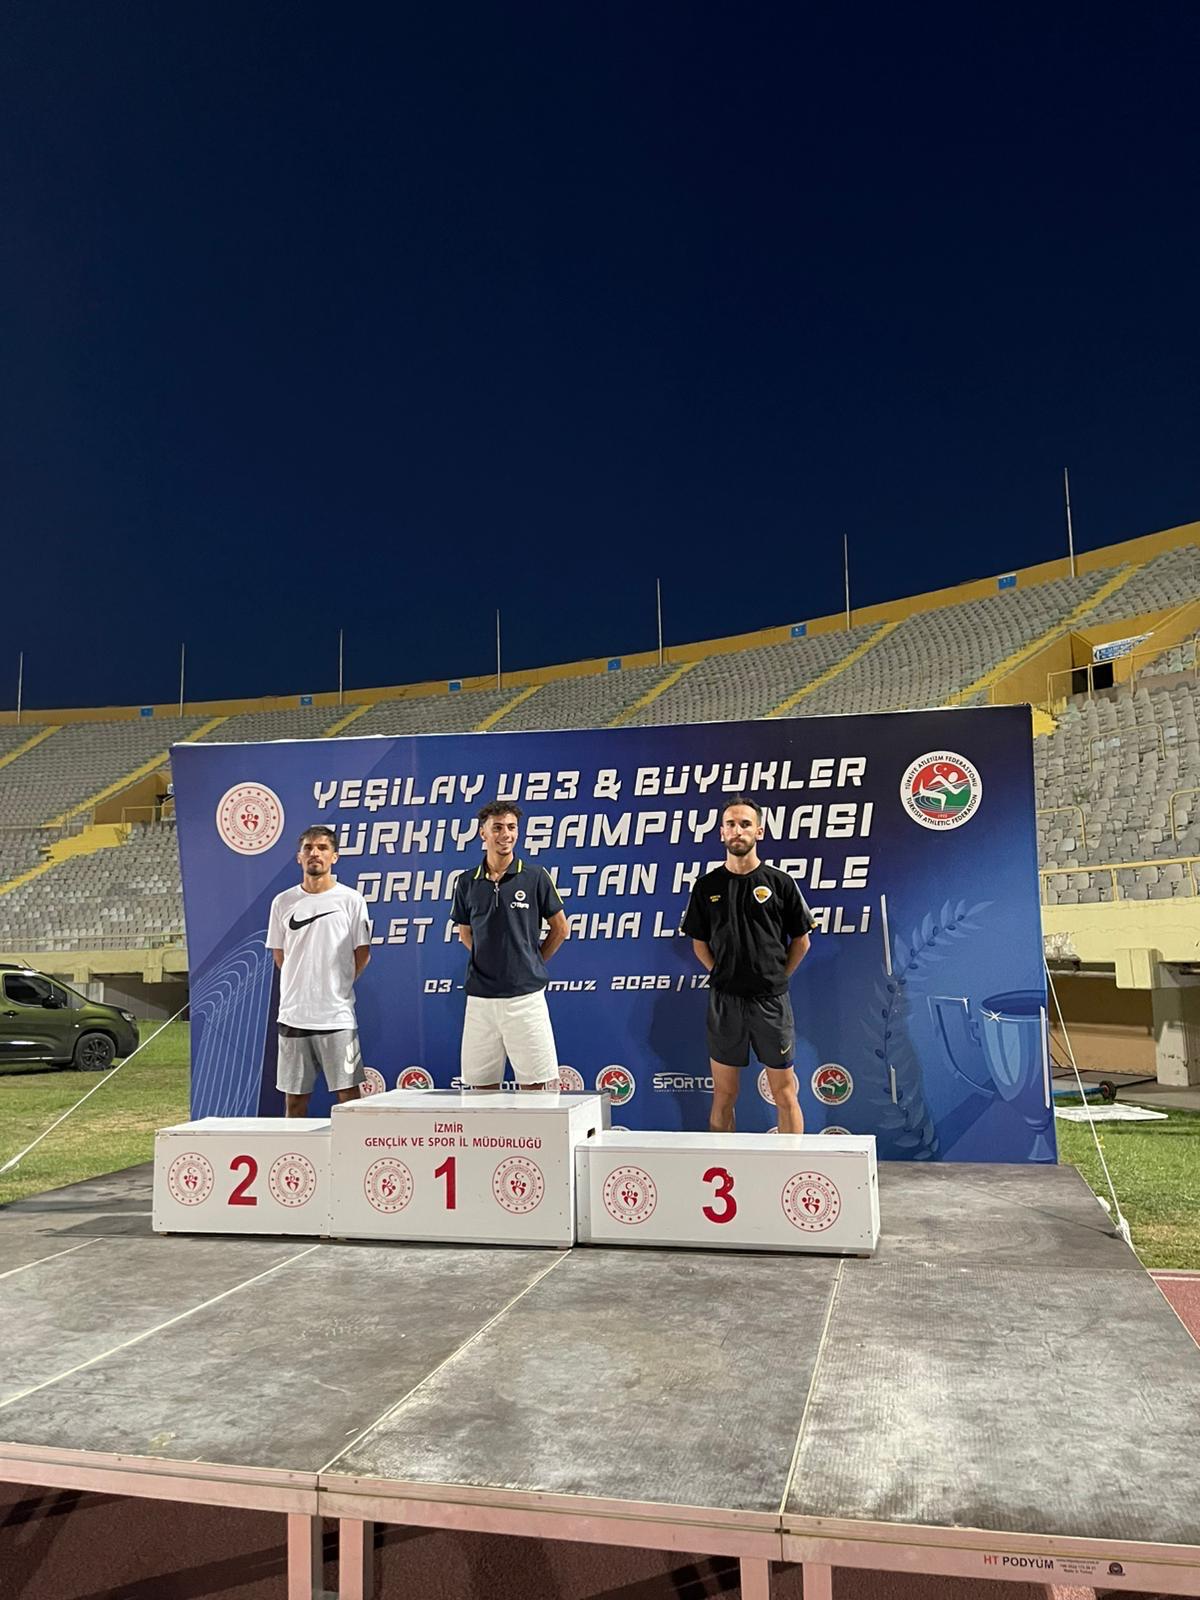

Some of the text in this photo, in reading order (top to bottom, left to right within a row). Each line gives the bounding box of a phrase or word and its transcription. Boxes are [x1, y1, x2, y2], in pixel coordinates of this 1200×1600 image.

[497, 771, 579, 801] U23
[593, 769, 622, 801] &
[634, 757, 867, 797] BÜYÜKLER
[945, 755, 978, 787] FEDERASYONU
[923, 816, 951, 826] ATHLETIC
[951, 794, 978, 824] FEDERATION
[312, 818, 488, 855] ÜRKİY
[524, 802, 874, 856] ŞAMPİYNASI
[550, 863, 658, 897] LTAN
[672, 856, 870, 894] KPLE
[424, 979, 452, 993] 03
[611, 975, 671, 990] 2026
[652, 1076, 715, 1089] SPORTO
[364, 1135, 542, 1149] GENÇLİK VE SPOR İL MÜDÜRLÜĞÜ
[434, 1121, 464, 1133] İZMİR
[228, 1155, 258, 1206] 2
[434, 1156, 456, 1210] 1
[702, 1167, 737, 1224] 3
[983, 1554, 999, 1565] HT
[1002, 1556, 1054, 1569] PODYUM
